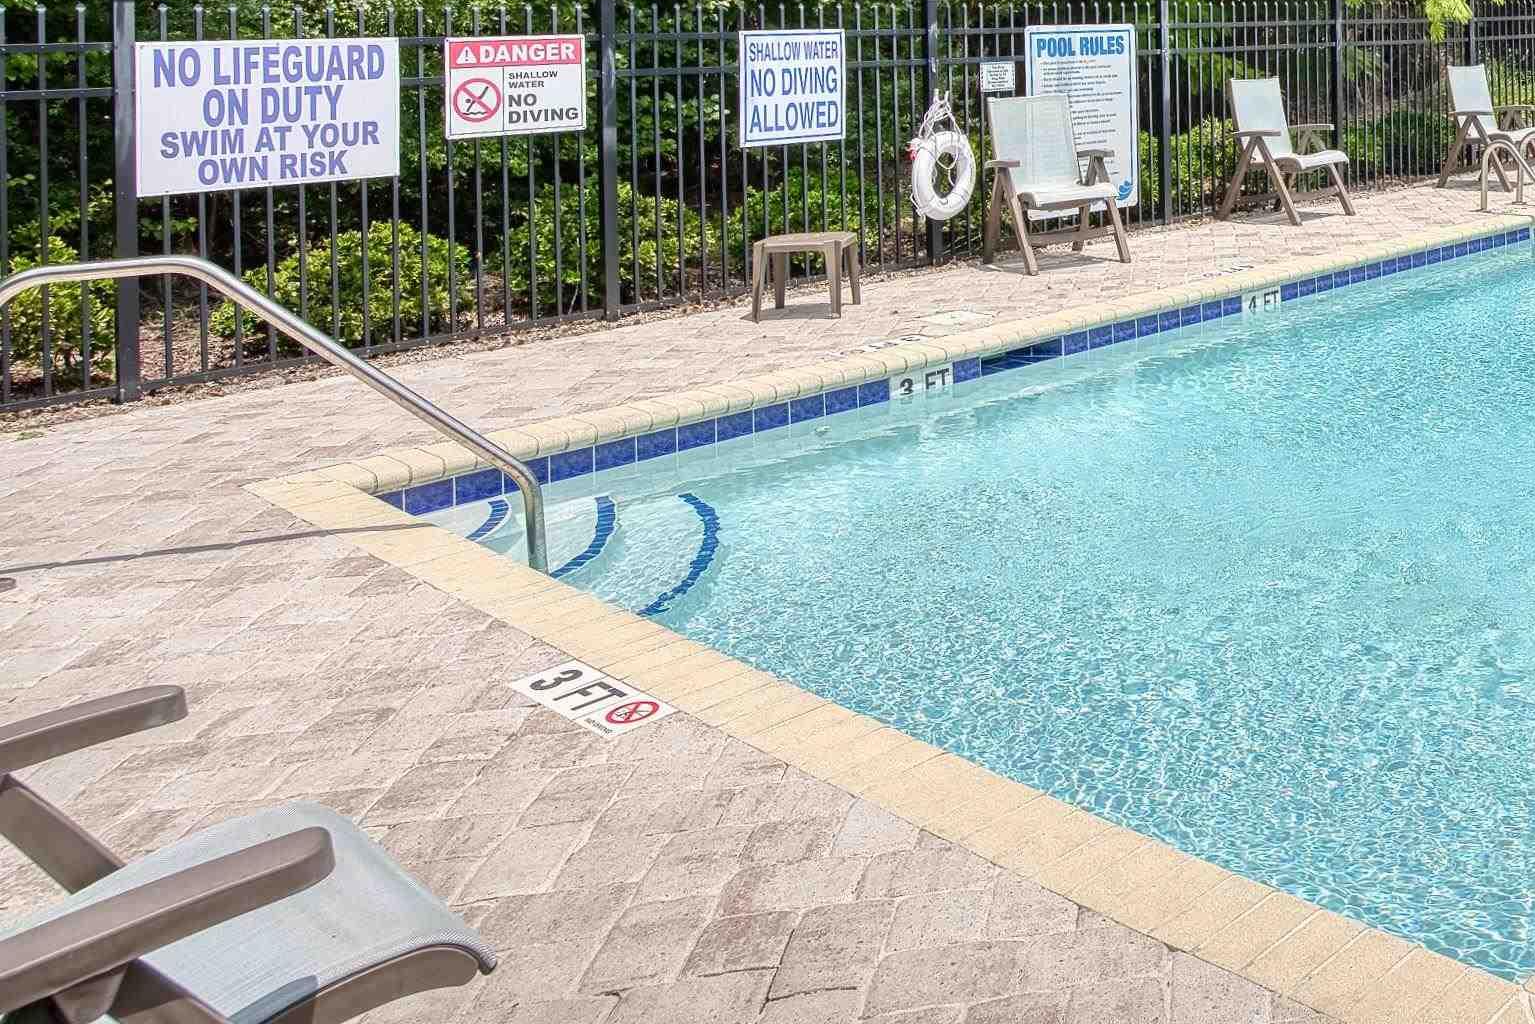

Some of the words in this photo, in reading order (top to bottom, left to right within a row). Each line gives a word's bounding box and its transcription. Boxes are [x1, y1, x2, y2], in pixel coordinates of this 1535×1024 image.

[479, 42, 577, 63] DANGER
[749, 41, 801, 62] SHALLOW
[803, 40, 838, 60] WATER
[1037, 37, 1076, 58] POOL
[1079, 35, 1125, 56] RULES
[153, 47, 201, 88] NO
[213, 43, 385, 85] LIFEGUARD
[508, 70, 558, 80] SHALLOW
[508, 80, 545, 89] WATER
[750, 67, 776, 97] NO
[781, 65, 838, 96] DIVING
[202, 88, 249, 127] ON
[261, 84, 344, 124] DUTY
[508, 93, 537, 108] NO
[508, 107, 579, 124] DIVING
[749, 100, 839, 133] ALLOWED
[160, 128, 245, 159] SWIM
[254, 126, 292, 153] AT
[301, 120, 380, 149] YOUR
[198, 155, 269, 186] OWN
[279, 149, 348, 179] RISK
[1263, 289, 1279, 306] FT
[900, 378, 914, 395] 3
[925, 367, 950, 390] FT
[529, 669, 583, 691] 3
[552, 681, 628, 711] FT
